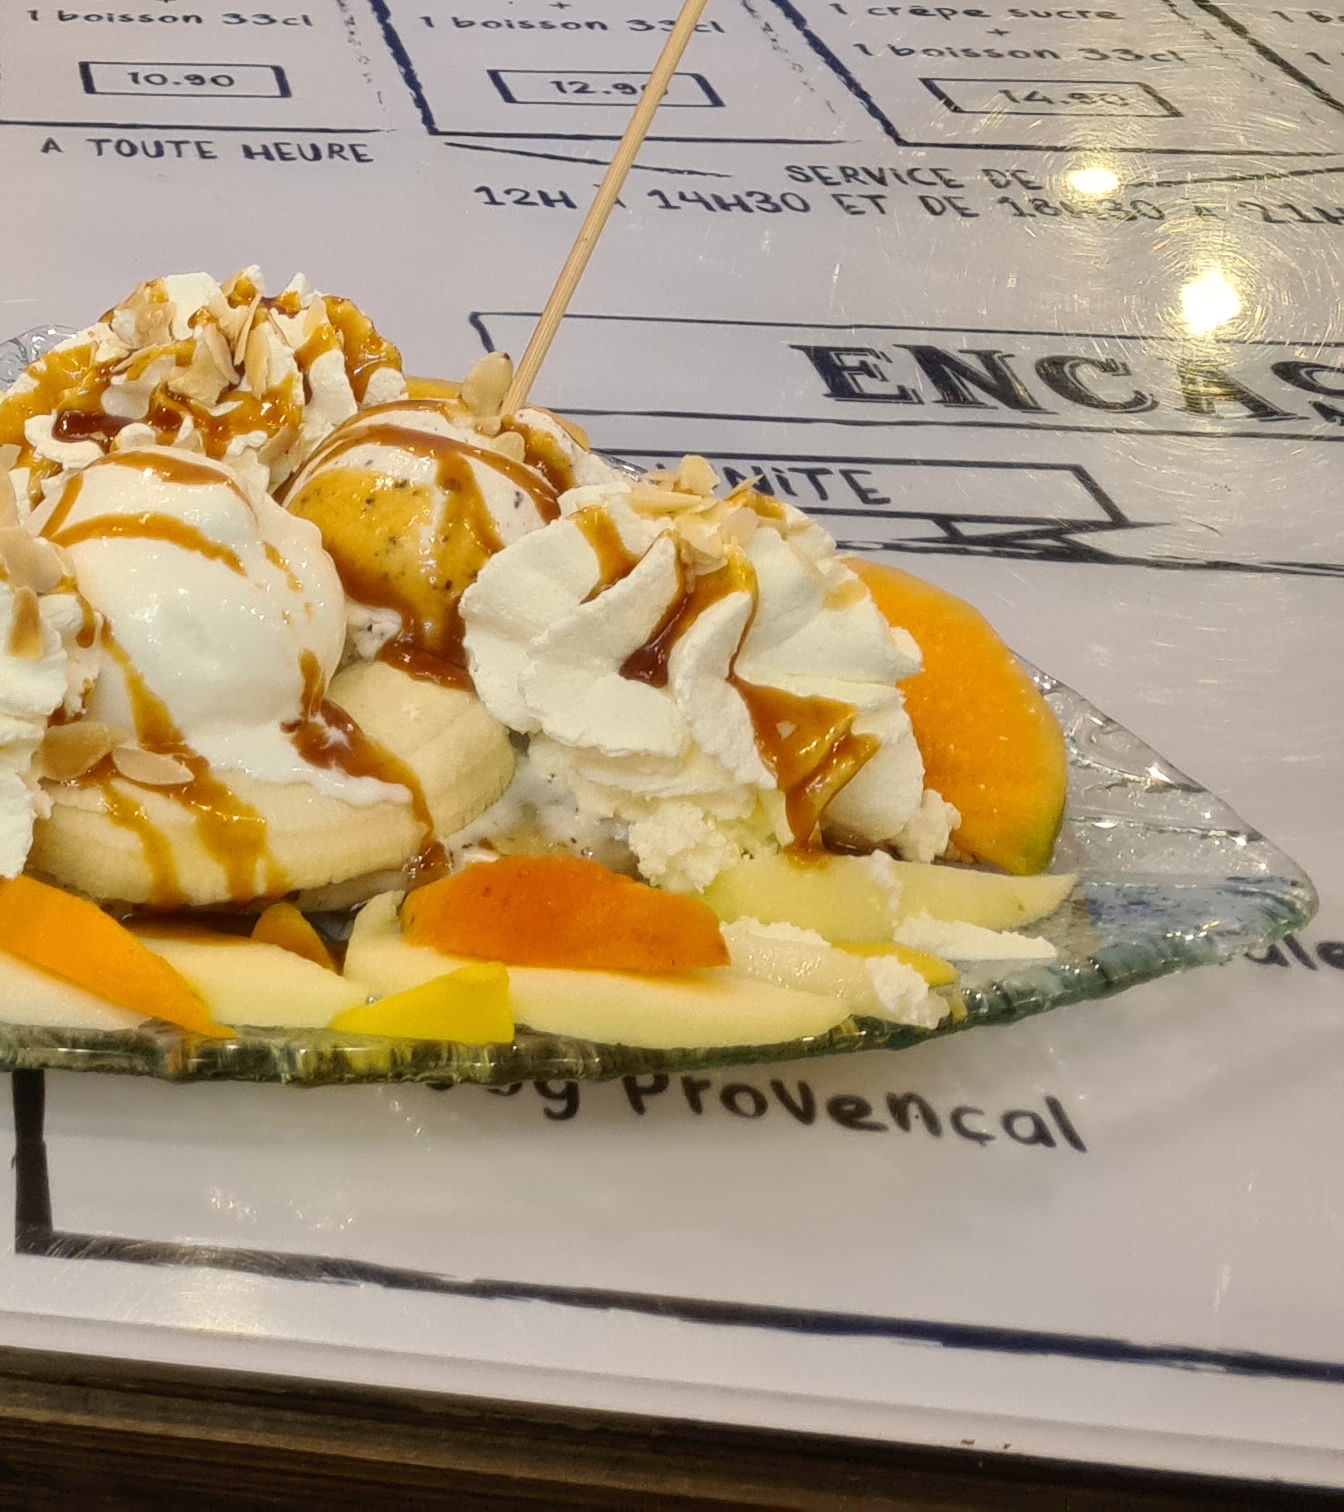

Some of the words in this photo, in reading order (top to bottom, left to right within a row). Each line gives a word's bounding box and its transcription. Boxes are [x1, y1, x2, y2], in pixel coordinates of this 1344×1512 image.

[27, 9, 39, 22] 1
[57, 9, 203, 24] boisson
[828, 2, 848, 16] 1
[1007, 8, 1125, 20] sucre
[420, 16, 435, 28] 1
[451, 16, 609, 31] boisson
[852, 43, 874, 57] 1
[887, 43, 1061, 60] boisson
[127, 71, 235, 88] 10.90
[550, 80, 669, 97] 12.9
[86, 138, 218, 160] TOUTE
[241, 141, 374, 163] HEURE
[980, 168, 1044, 191] DE
[474, 185, 578, 210] 12H
[646, 189, 811, 214] 14H30
[830, 193, 888, 216] ET
[917, 194, 980, 218] DE
